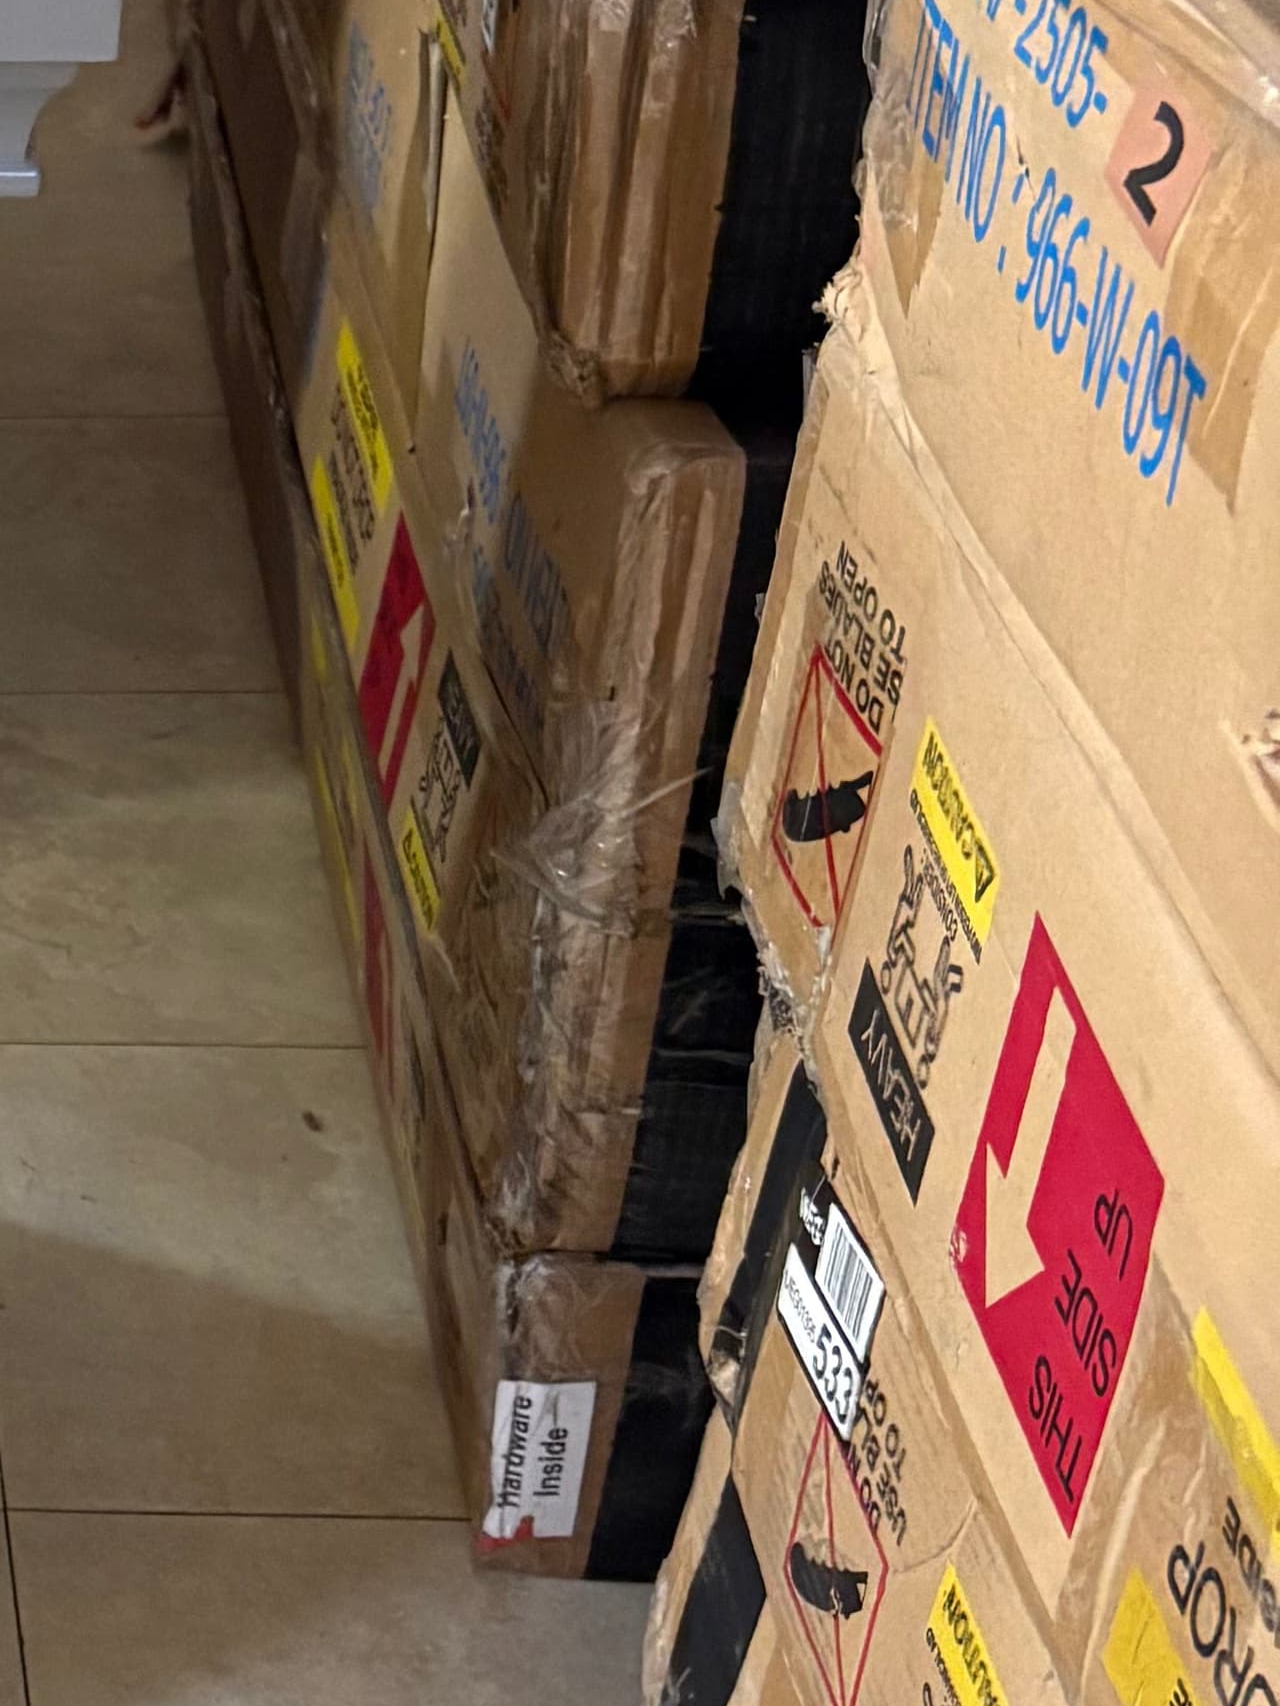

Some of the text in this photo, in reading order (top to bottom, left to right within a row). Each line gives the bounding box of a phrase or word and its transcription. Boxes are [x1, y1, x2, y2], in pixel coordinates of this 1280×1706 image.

[1123, 100, 1186, 227] 2
[956, 77, 1006, 243] NO
[1016, 168, 1207, 506] 966-W-09T
[836, 541, 906, 664] TO OPEN
[856, 678, 884, 735] DO
[859, 1008, 922, 1162] HEAVY
[1094, 1189, 1133, 1280] UP
[813, 1323, 854, 1425] 533
[1054, 1249, 1116, 1398] SIDE
[497, 1395, 533, 1509] Hardware
[532, 1427, 569, 1497] Inside
[1028, 1355, 1087, 1504] THIS
